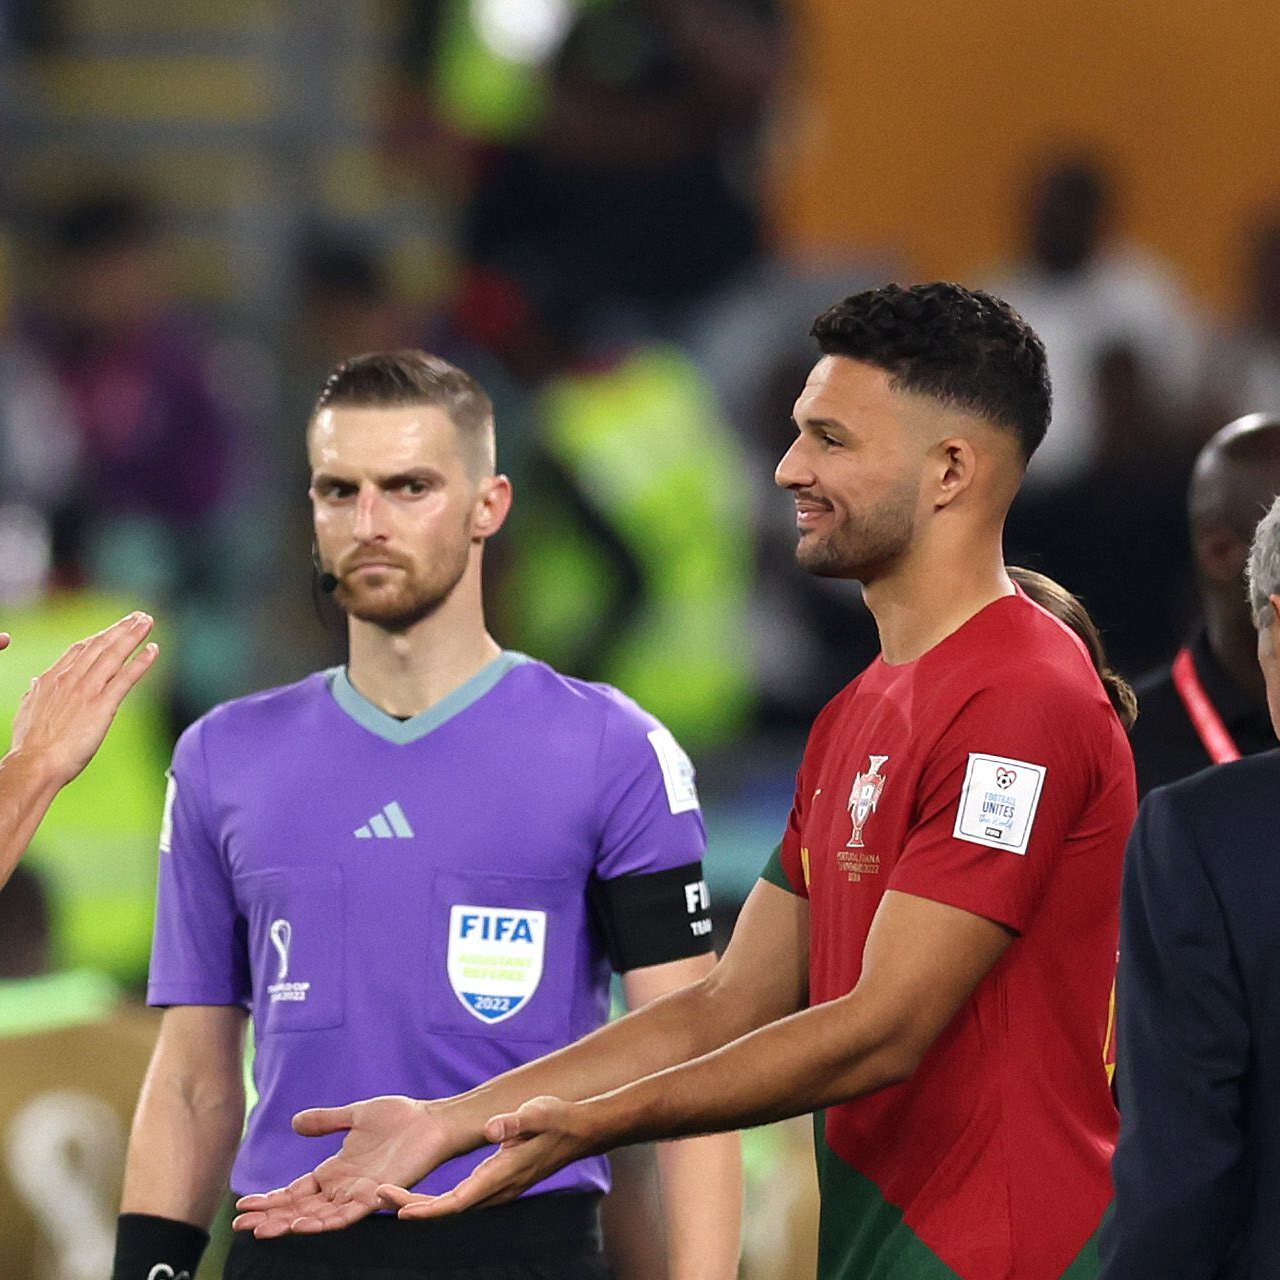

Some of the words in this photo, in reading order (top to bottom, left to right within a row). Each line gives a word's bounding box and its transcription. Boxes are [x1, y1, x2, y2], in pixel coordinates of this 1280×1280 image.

[982, 801, 1015, 818] UNITES
[460, 914, 533, 944] FIFA
[474, 996, 511, 1012] 2022
